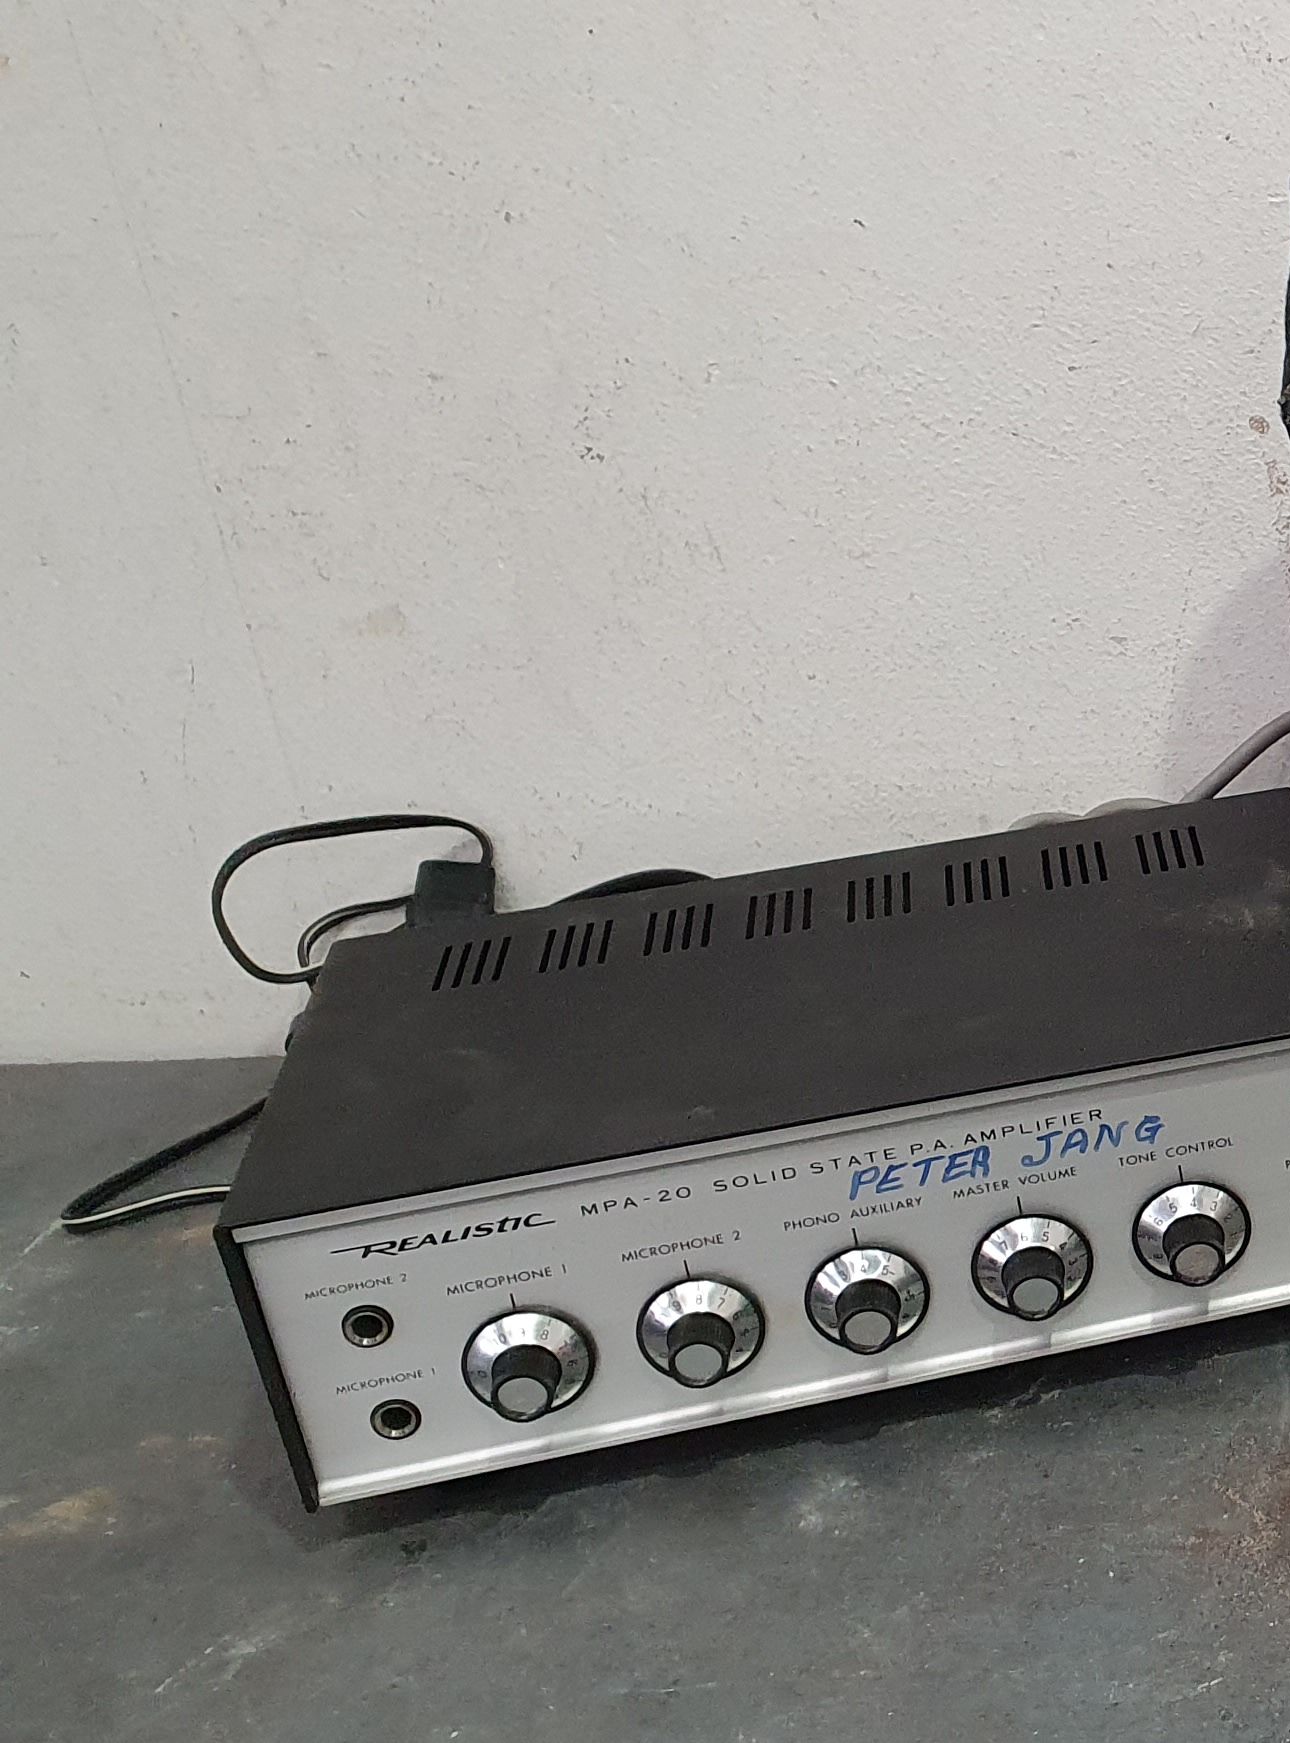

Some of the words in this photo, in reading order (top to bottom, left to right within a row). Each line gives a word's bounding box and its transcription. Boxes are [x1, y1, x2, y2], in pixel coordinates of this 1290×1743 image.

[580, 1186, 692, 1217] MPA-20
[713, 1166, 797, 1193] SOLID
[810, 1147, 897, 1175] STATE
[910, 1138, 954, 1155] P.A.
[963, 1108, 1103, 1145] AMPLIFIER
[849, 1145, 991, 1200] PETER
[1021, 1114, 1166, 1168] JANG
[1118, 1151, 1158, 1167] TONE
[1165, 1136, 1235, 1158] CONTROL
[952, 1180, 1010, 1200] MASTER
[1017, 1166, 1078, 1186] VOLUME
[783, 1212, 840, 1232] PHONO
[849, 1196, 923, 1219] AUXILIARY
[621, 1234, 725, 1263] MICROPHONE
[733, 1230, 742, 1243] 2
[303, 1276, 394, 1300] MICROPHONE
[400, 1272, 408, 1283] 2
[446, 1267, 553, 1296] MICROPHONE
[335, 1370, 424, 1396] MICROPHONE
